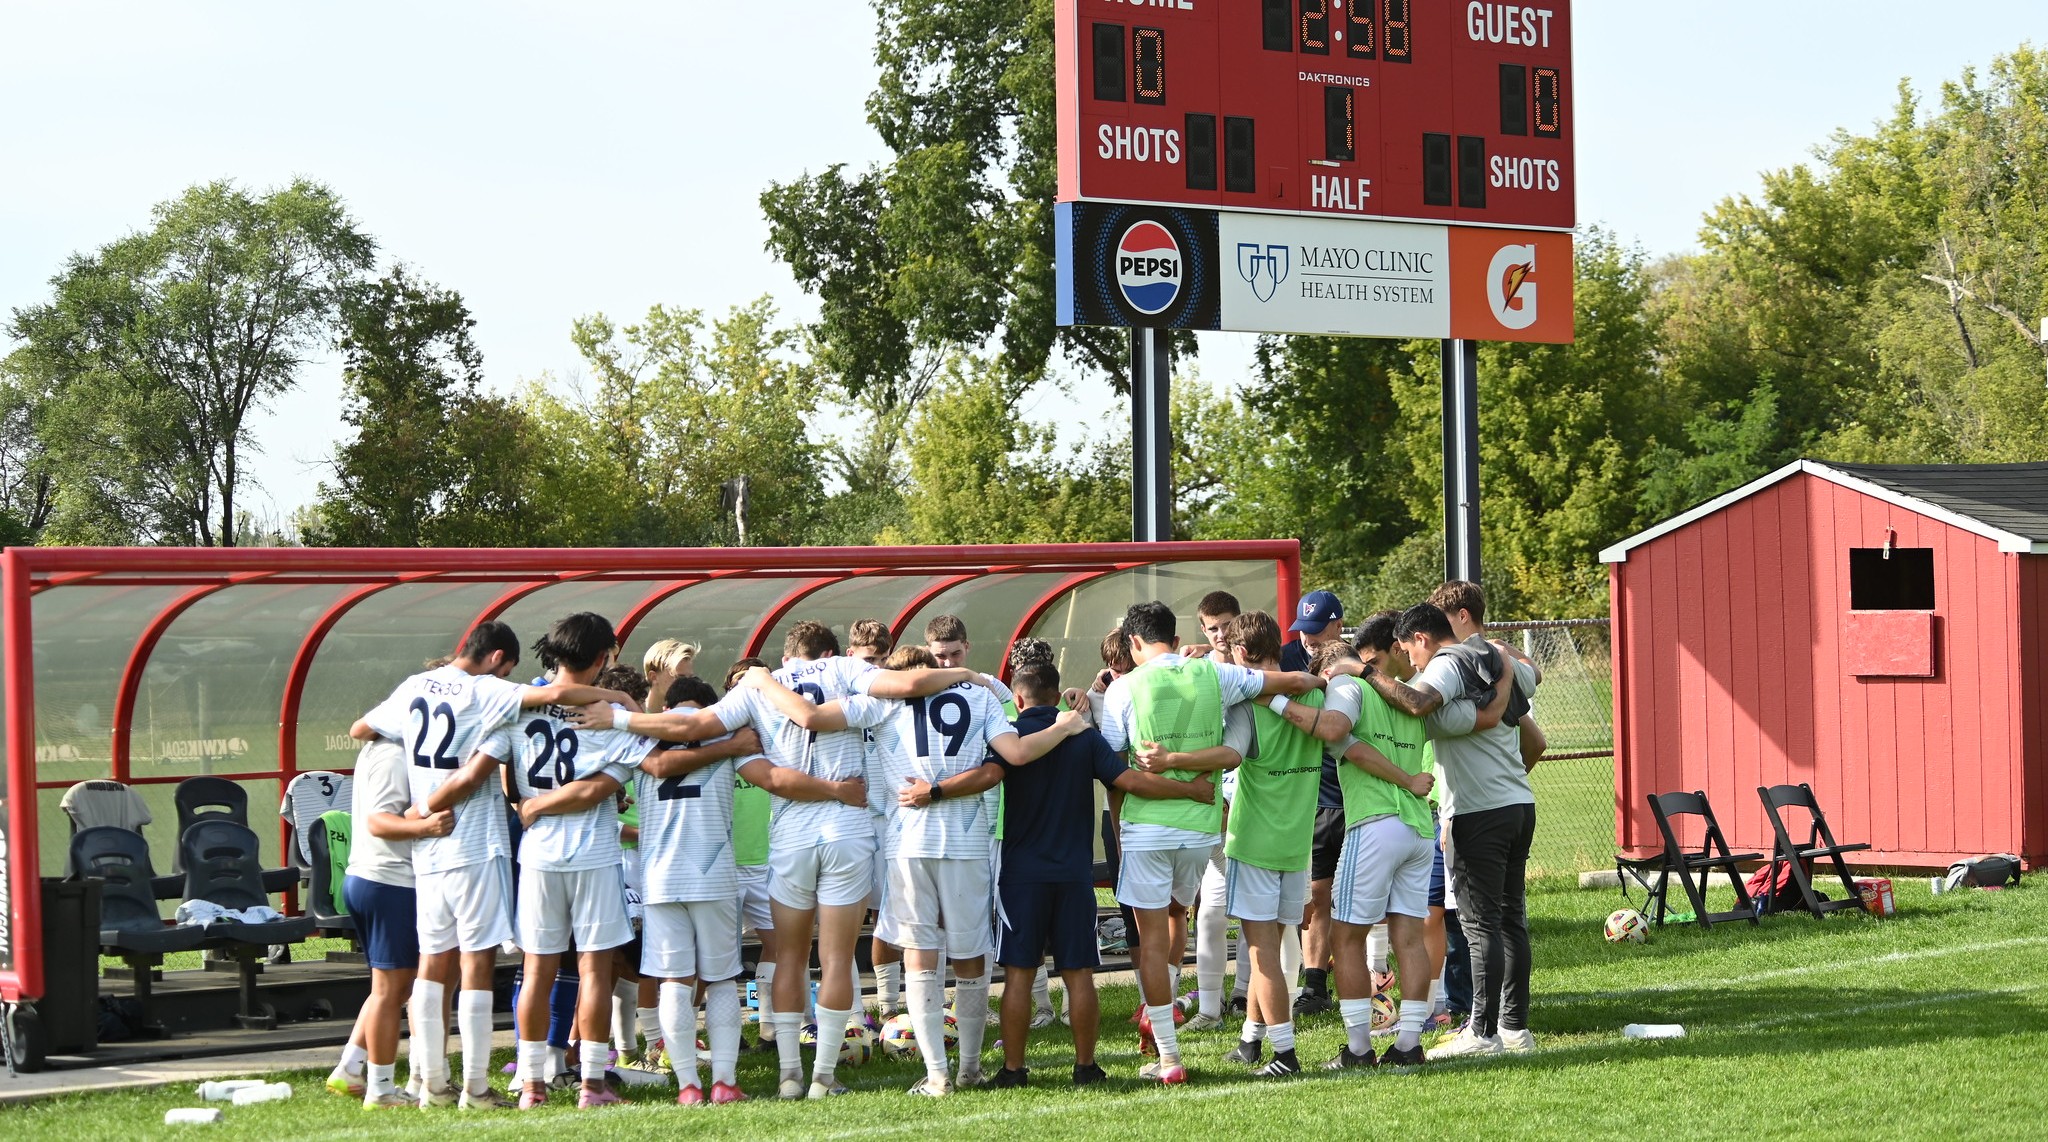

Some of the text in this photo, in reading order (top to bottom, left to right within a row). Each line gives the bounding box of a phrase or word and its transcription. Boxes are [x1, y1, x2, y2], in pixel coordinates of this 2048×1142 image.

[1302, 0, 1409, 57] 2:58
[1467, 1, 1553, 48] GUEST
[1135, 29, 1163, 98] 0
[1298, 71, 1370, 87] DAKTRONICS
[1534, 68, 1558, 132] 0
[1098, 124, 1180, 164] SHOTS
[1311, 174, 1371, 211] HALF
[1490, 155, 1560, 192] SHOTS
[1120, 256, 1178, 278] PEPSI
[1300, 246, 1433, 274] MAYO CLINIC
[1300, 281, 1434, 304] HEALTH SYSTEM
[1486, 244, 1537, 330] G
[409, 696, 459, 770] 22
[905, 692, 972, 758] 19
[1374, 732, 1386, 740] NET
[525, 719, 578, 790] 28
[318, 775, 334, 797] 3
